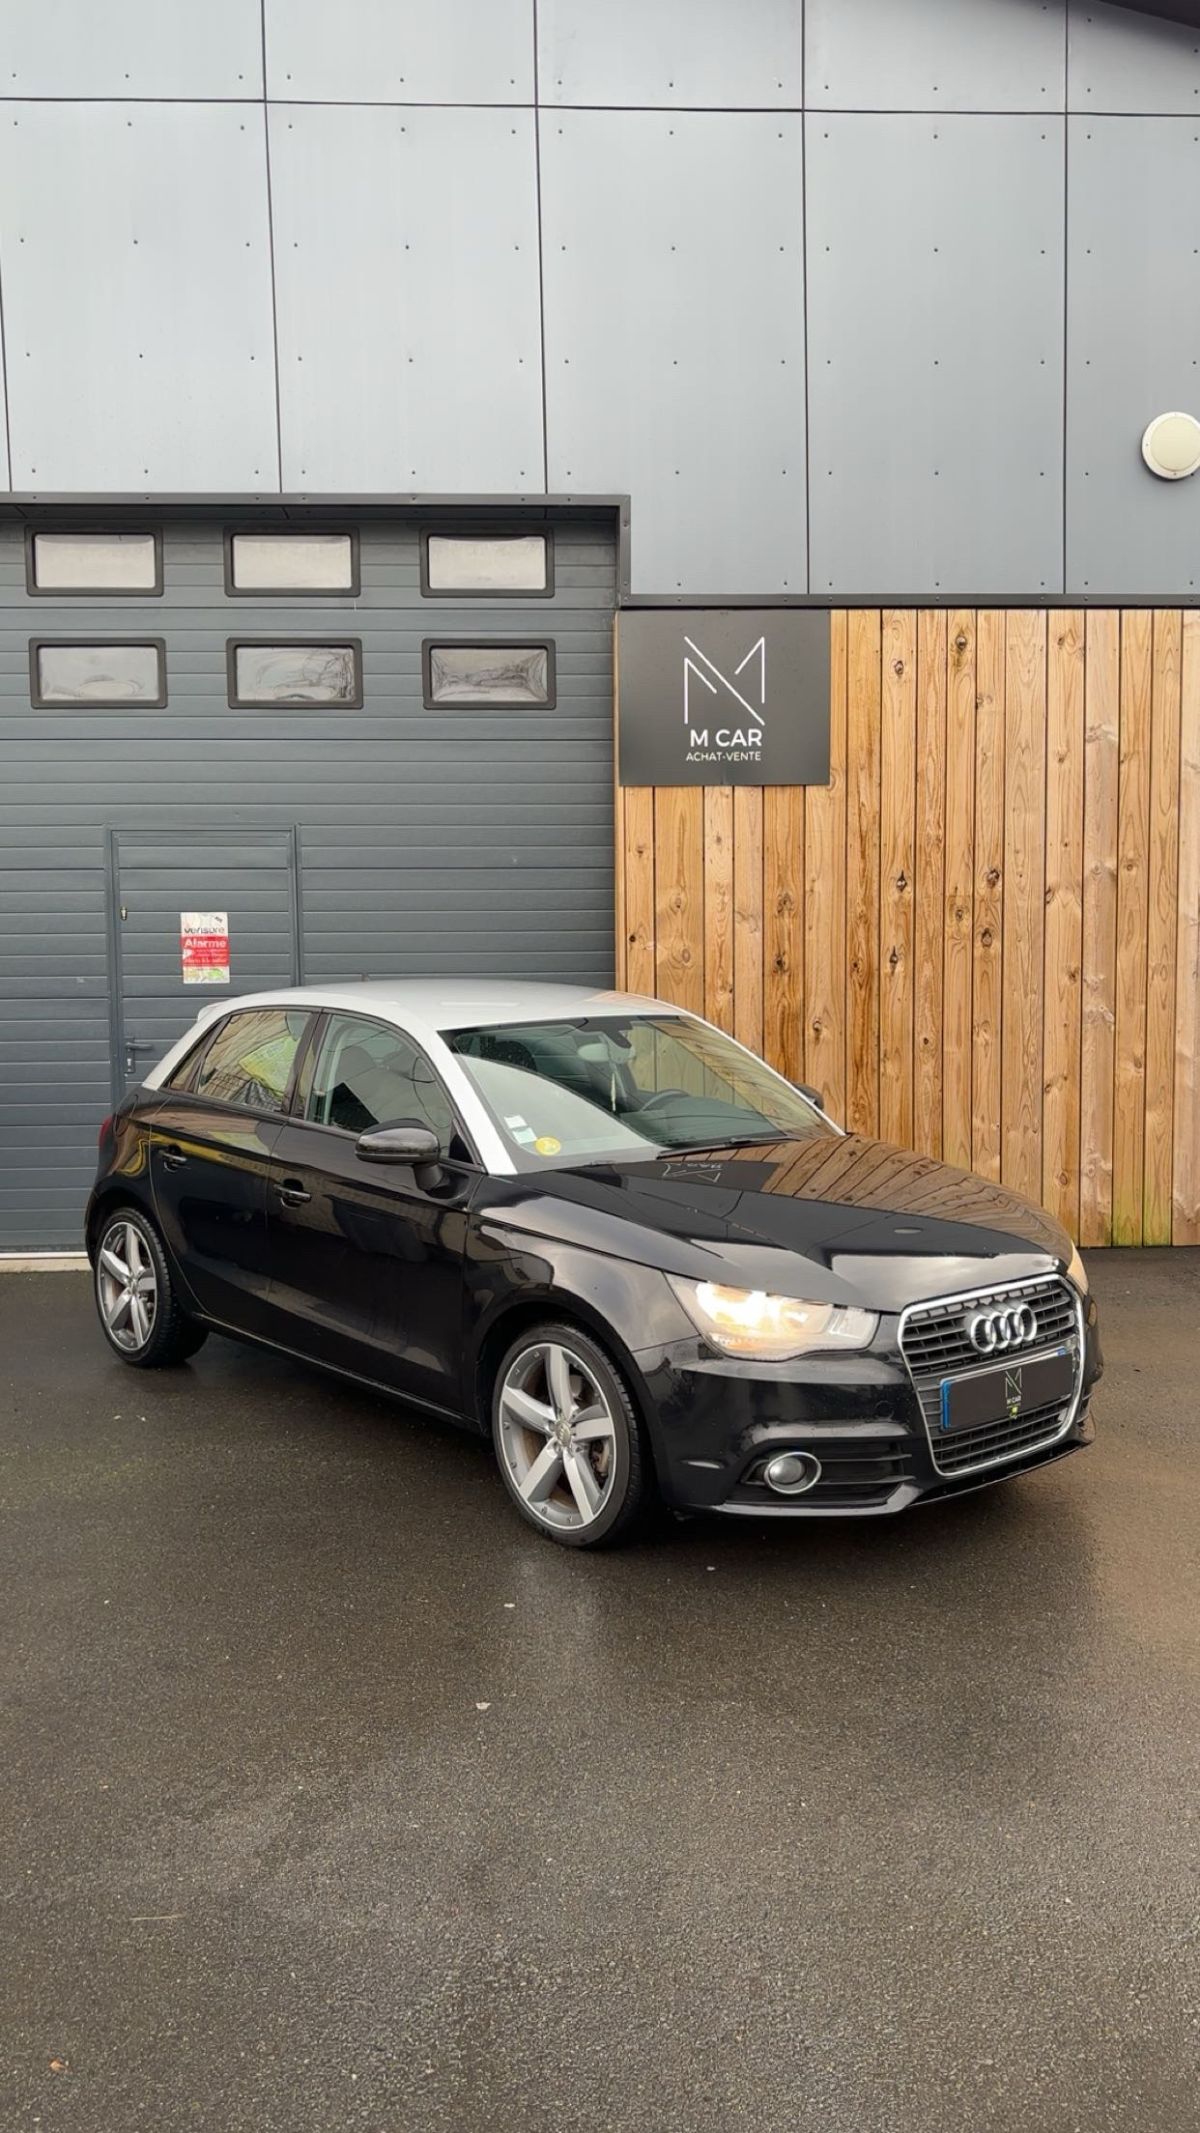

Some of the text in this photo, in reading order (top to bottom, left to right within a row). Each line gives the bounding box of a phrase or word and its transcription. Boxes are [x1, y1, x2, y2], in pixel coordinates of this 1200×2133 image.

[690, 728, 763, 748] M CAR
[685, 751, 762, 762] ACHAT-VENTE
[184, 938, 227, 948] Alarme
